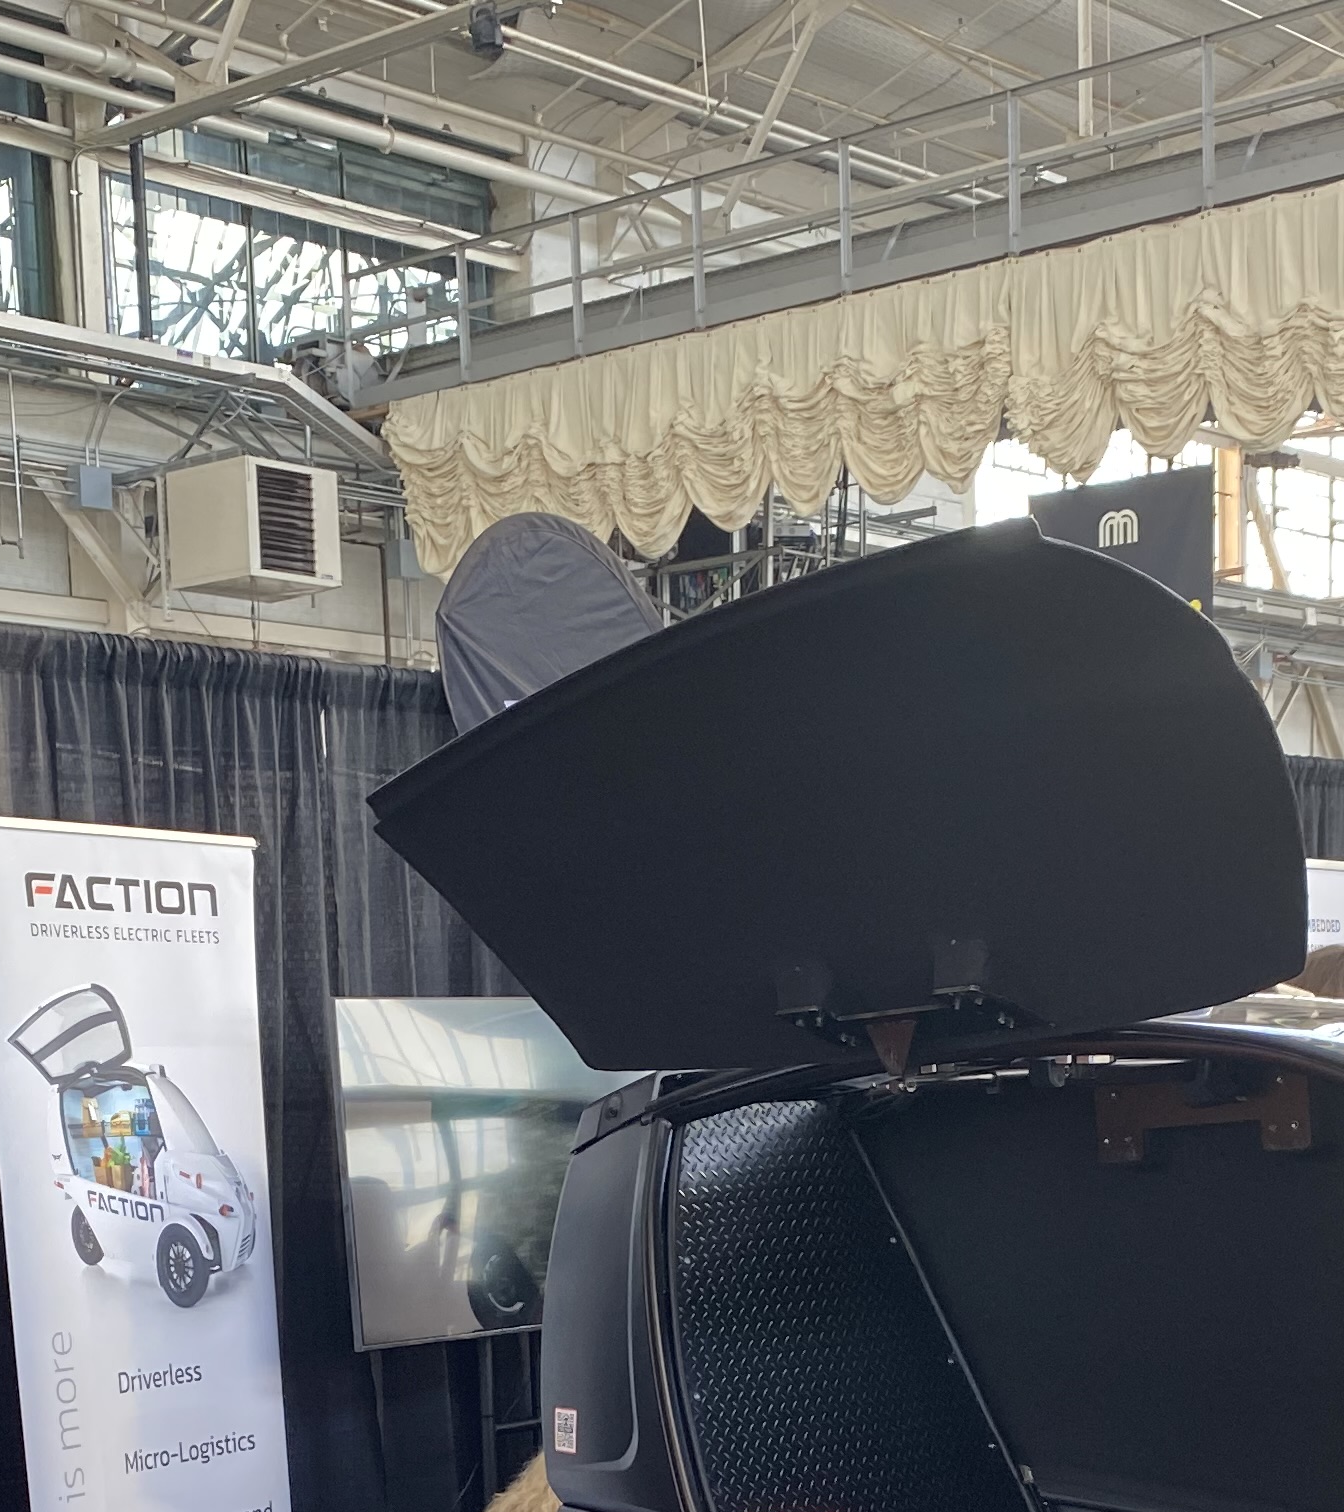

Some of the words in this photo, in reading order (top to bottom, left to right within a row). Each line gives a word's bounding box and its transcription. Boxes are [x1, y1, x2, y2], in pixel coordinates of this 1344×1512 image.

[24, 872, 218, 916] FACTION
[30, 922, 110, 940] DRIVERLESS
[114, 926, 172, 943] ELECTRIC
[176, 929, 220, 945] FLEETS
[87, 1190, 165, 1222] FACTION
[51, 1331, 82, 1450] more
[117, 1363, 203, 1394] Driverless
[124, 1432, 256, 1475] Micro-Logistics
[58, 1467, 86, 1503] is
